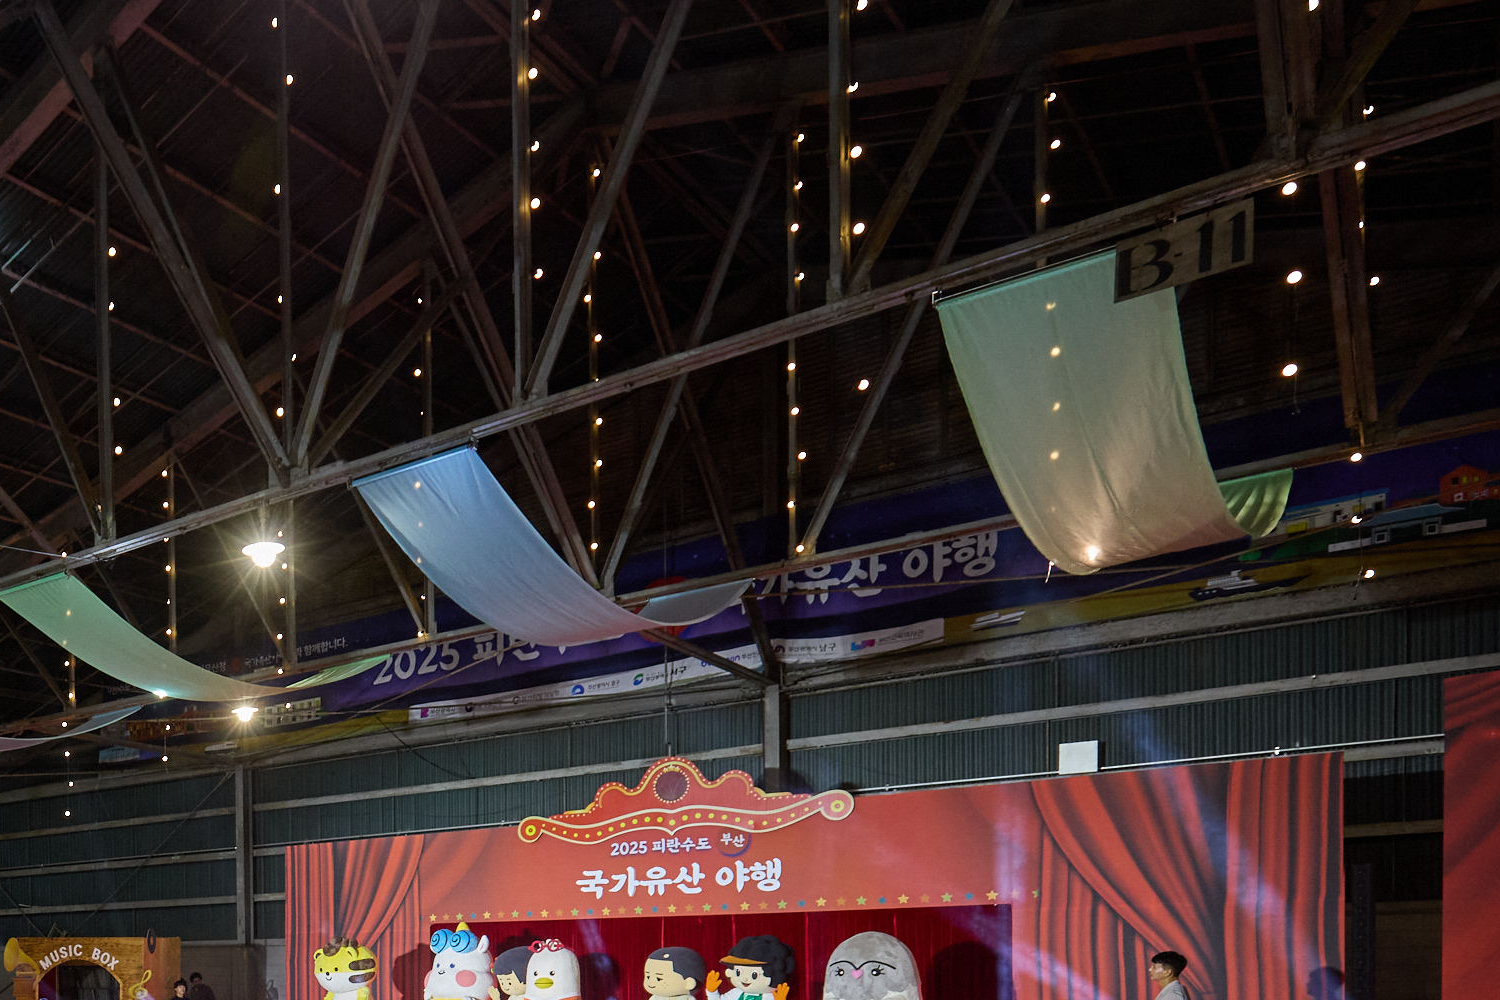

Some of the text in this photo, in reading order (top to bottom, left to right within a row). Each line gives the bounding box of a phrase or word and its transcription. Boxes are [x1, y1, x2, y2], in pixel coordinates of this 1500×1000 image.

[1118, 211, 1246, 298] B-11
[304, 637, 349, 656] 함께합니다.
[819, 643, 836, 652] 남구
[372, 639, 461, 686] 2025
[610, 832, 745, 857] 2025 피란수도 부산
[575, 857, 783, 900] 국가유산 야행
[39, 944, 120, 970] MUSIC BOX
